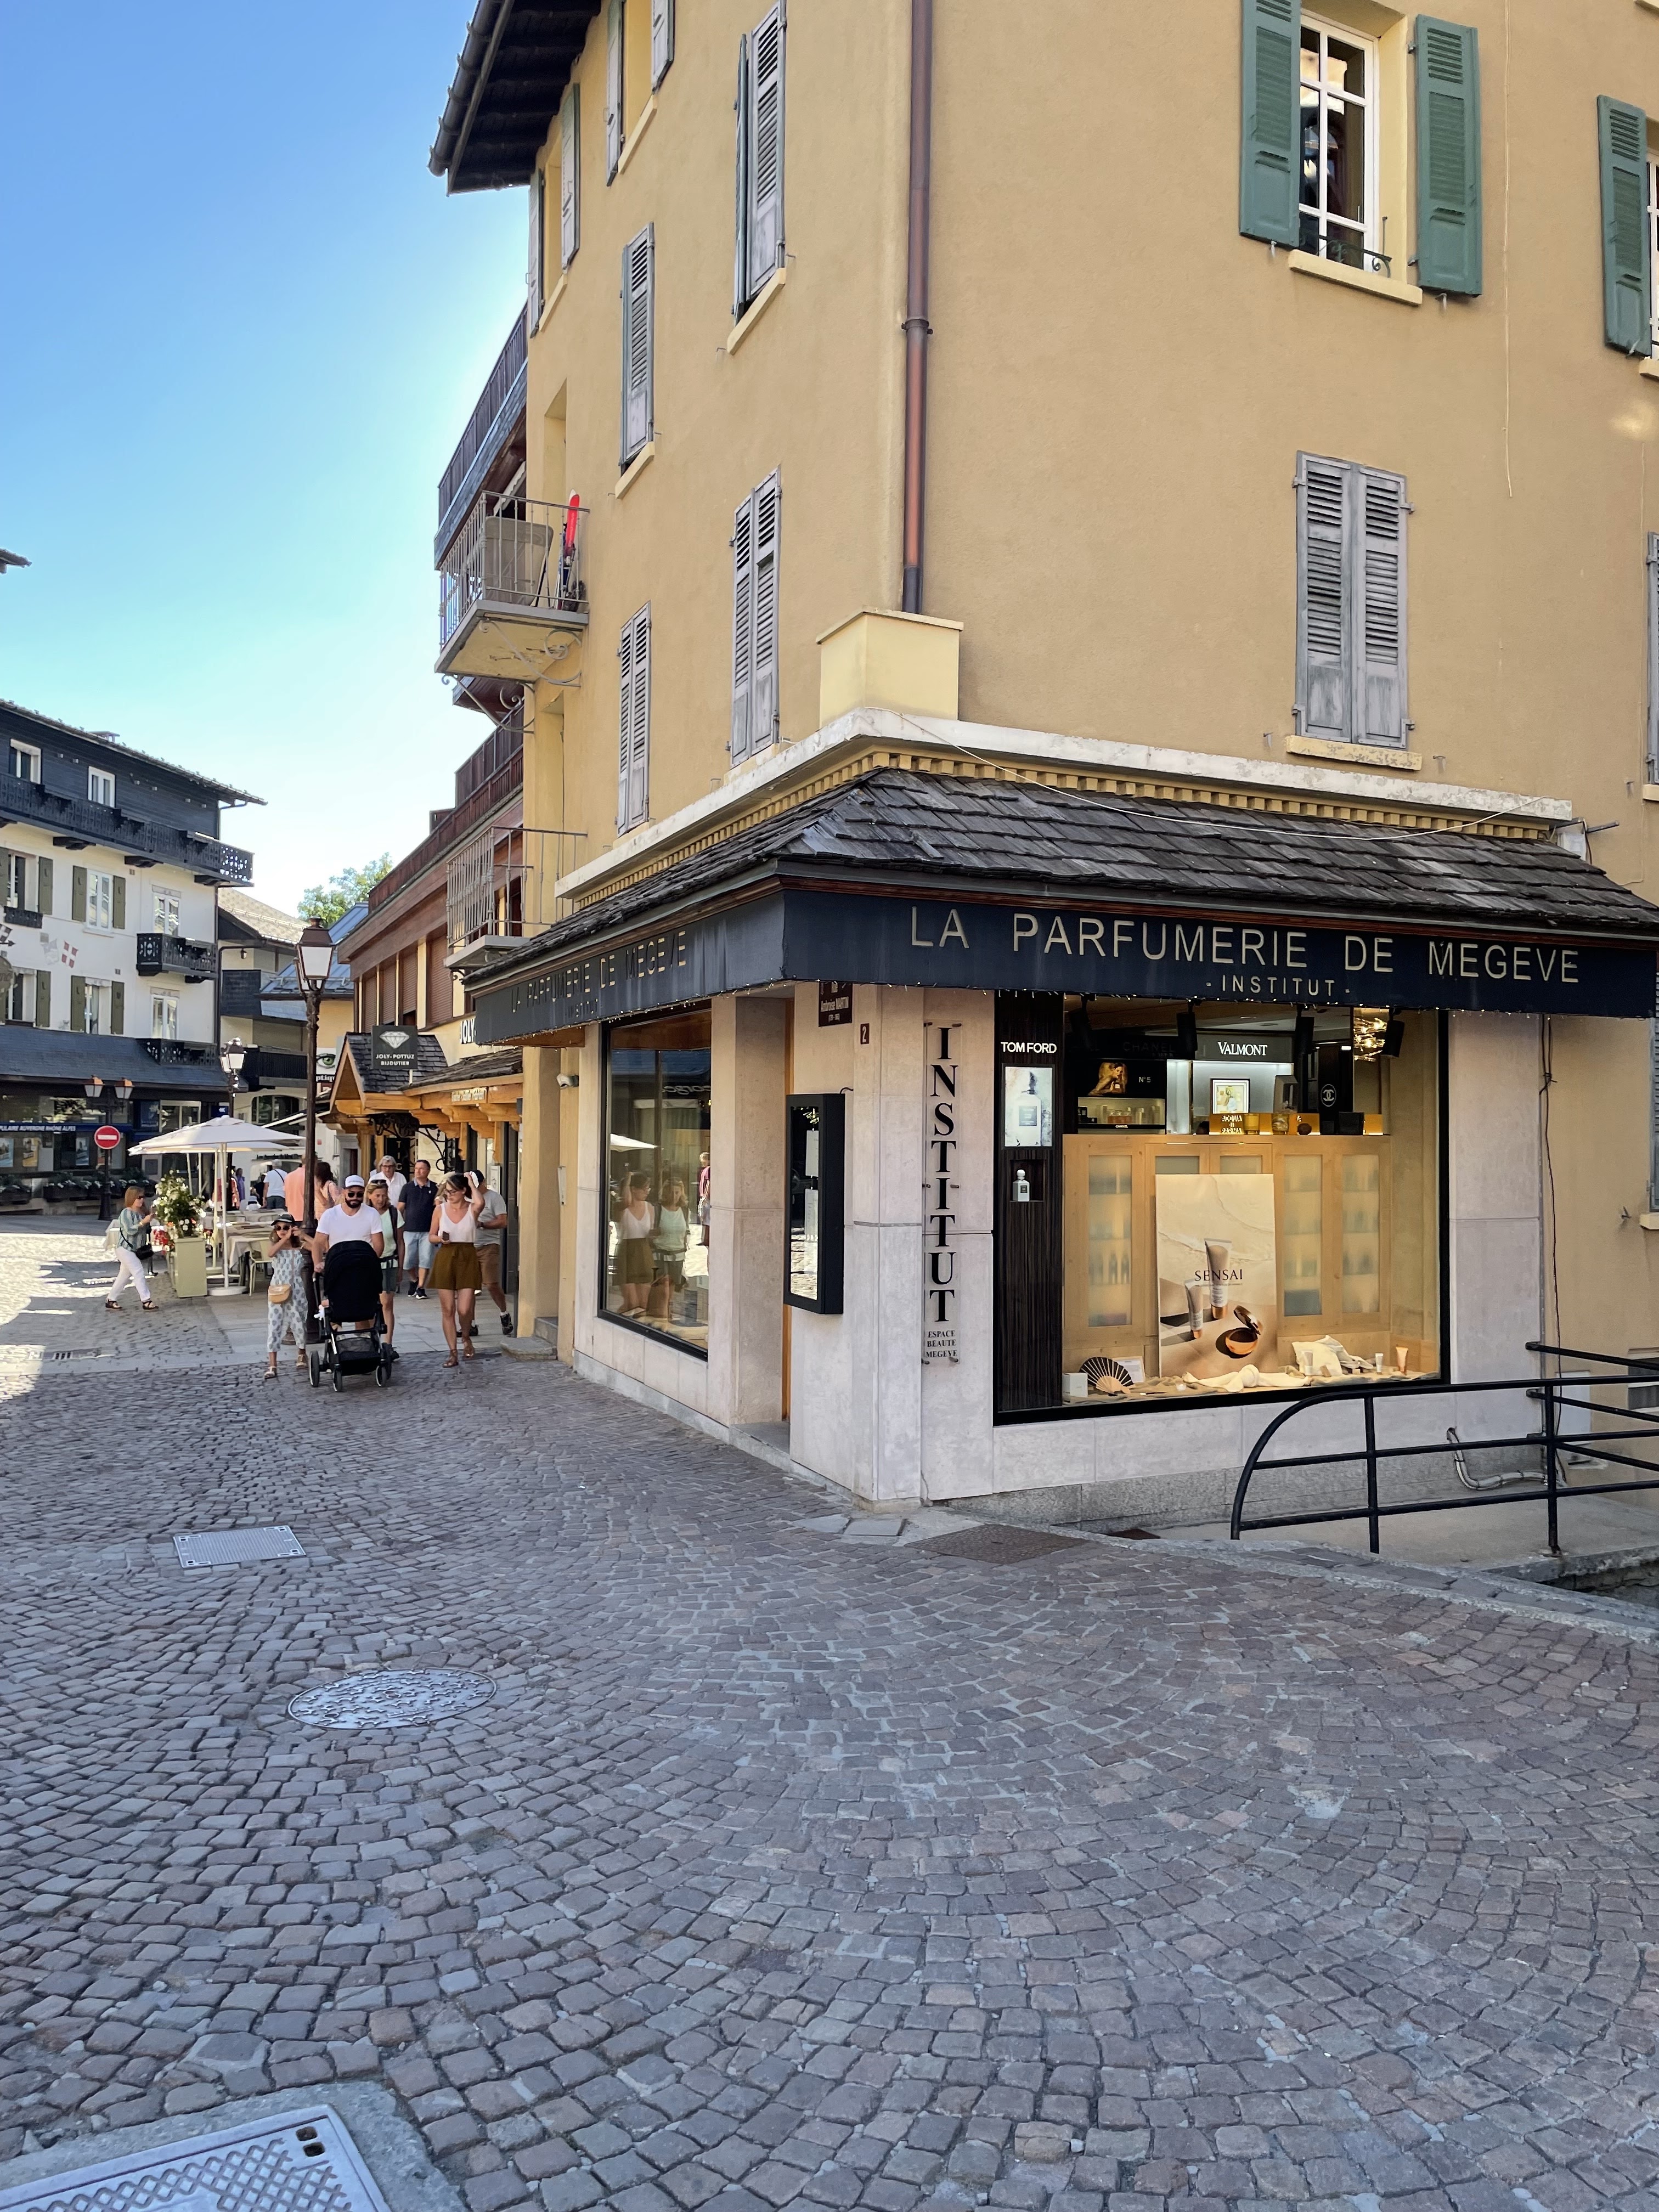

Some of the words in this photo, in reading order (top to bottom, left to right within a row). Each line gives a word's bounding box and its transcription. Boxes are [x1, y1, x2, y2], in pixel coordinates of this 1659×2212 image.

[912, 906, 969, 949] LA
[1013, 913, 1307, 968] PARFUMERIE
[1345, 935, 1393, 972] DE
[1429, 941, 1579, 983] MEGEVE
[1222, 974, 1335, 996] INSTITUT
[862, 1026, 867, 1042] 2
[1001, 1042, 1025, 1053] TOM
[1026, 1042, 1057, 1053] FORD
[1218, 1042, 1268, 1056] VALMONT
[928, 1027, 958, 1322] INSTITUT
[1194, 1269, 1243, 1281] SENSAI
